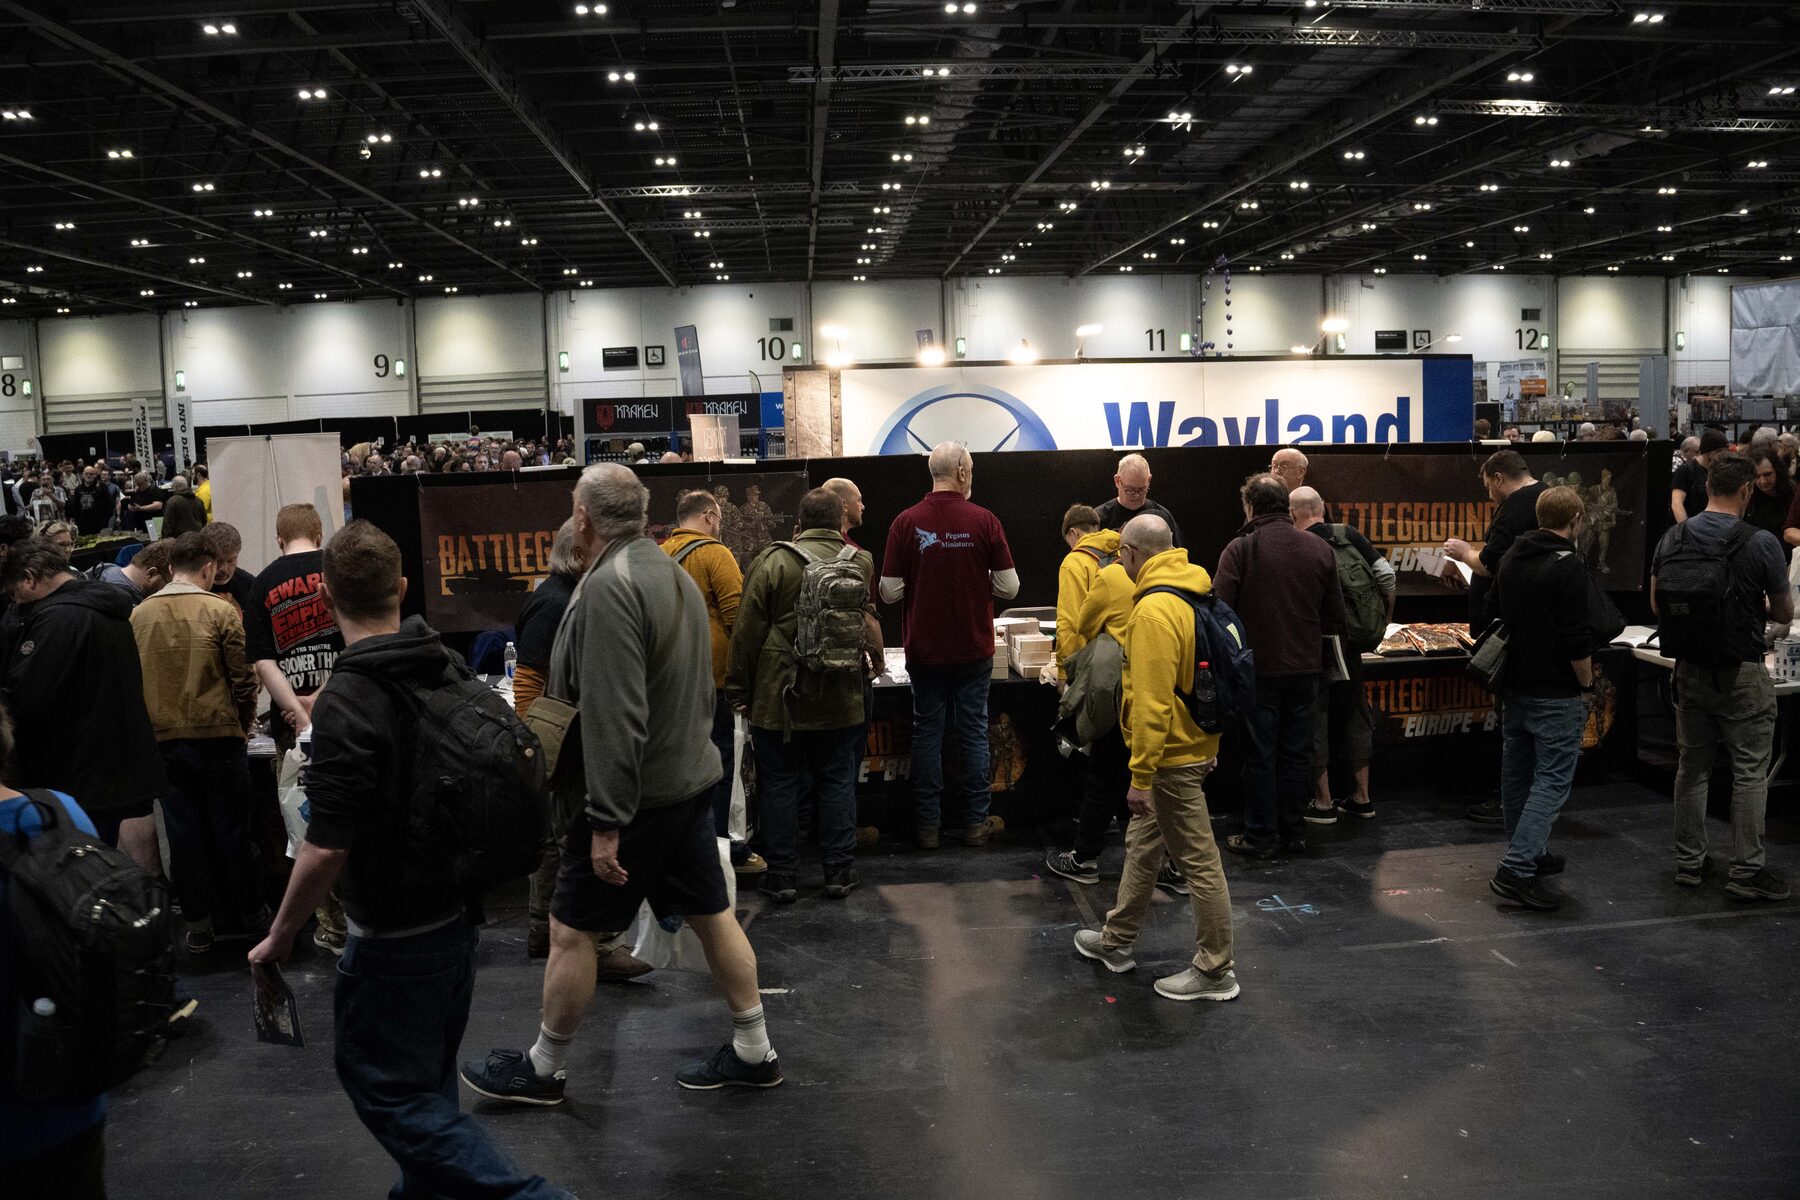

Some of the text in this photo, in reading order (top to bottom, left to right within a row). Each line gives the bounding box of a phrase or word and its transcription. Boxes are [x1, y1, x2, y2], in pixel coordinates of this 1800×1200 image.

[757, 336, 786, 361] 10
[1145, 328, 1166, 352] 11
[1515, 328, 1540, 351] 12
[373, 354, 390, 378] 9
[1, 373, 17, 397] 8
[614, 403, 659, 419] KRAKEN
[703, 400, 748, 415] KRAKEN
[135, 418, 143, 457] COMP
[140, 405, 151, 469] PAINTING
[177, 402, 191, 463] INFO DES
[1326, 501, 1497, 542] TTLEGROUN
[945, 532, 970, 540] Pegasus
[438, 531, 559, 575] BATTLEG
[264, 572, 322, 610] EWAR
[279, 650, 342, 674] SOONER THA
[308, 669, 332, 687] THIN
[1404, 711, 1499, 738] EUROPE '8
